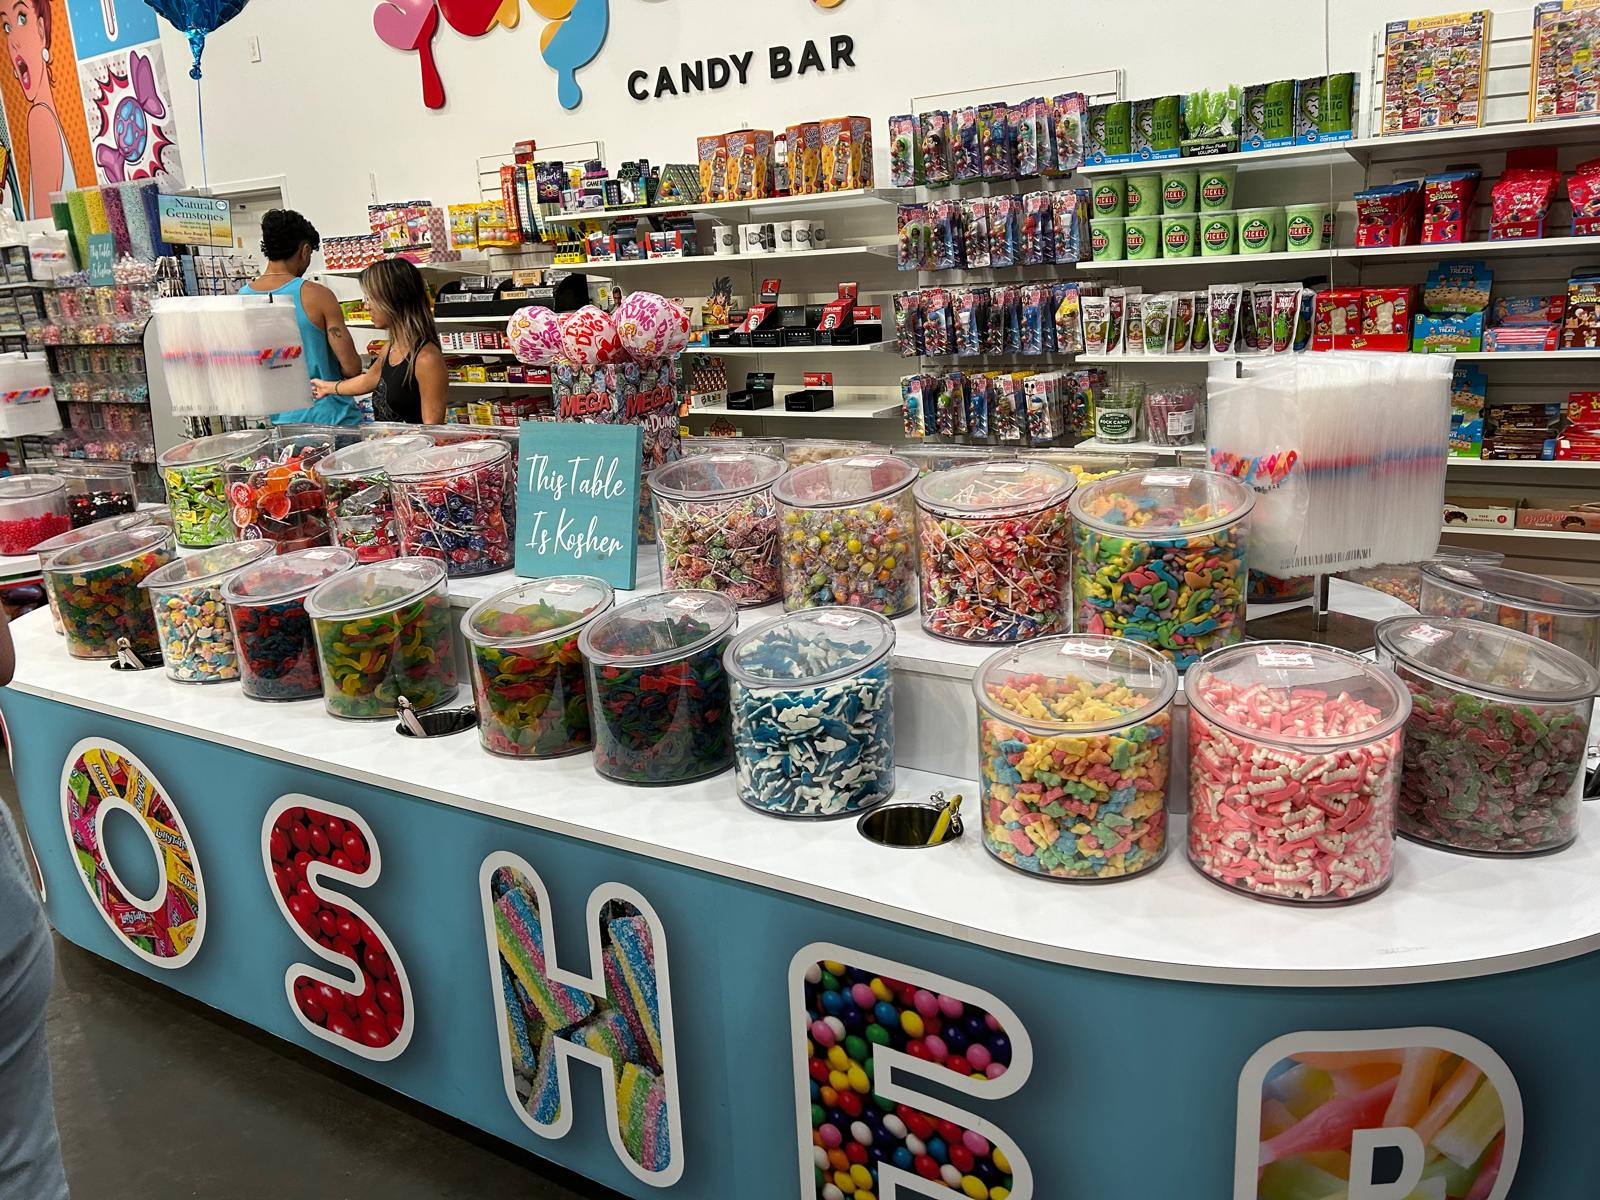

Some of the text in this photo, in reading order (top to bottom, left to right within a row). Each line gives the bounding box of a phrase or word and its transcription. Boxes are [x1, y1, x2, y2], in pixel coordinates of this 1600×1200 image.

[628, 34, 856, 100] CANDY BAR
[1268, 107, 1283, 117] BIG
[1157, 120, 1171, 130] BIG
[1109, 126, 1123, 135] BIG
[1198, 148, 1219, 156] LOLLIPOPS
[1165, 190, 1185, 199] PICKLE
[1203, 188, 1225, 196] PICKLE
[175, 198, 213, 210] Natural
[1096, 196, 1116, 204] PICKLE
[166, 209, 224, 222] Gemstones
[1207, 232, 1227, 240] PICKLE
[1245, 230, 1267, 239] PICKLE
[1289, 227, 1312, 235] PICKLE
[560, 392, 611, 418] MEGA
[626, 385, 673, 418] MEGA
[526, 453, 626, 500] This Table
[525, 507, 624, 559] Is Kosher
[169, 834, 187, 850] Taff
